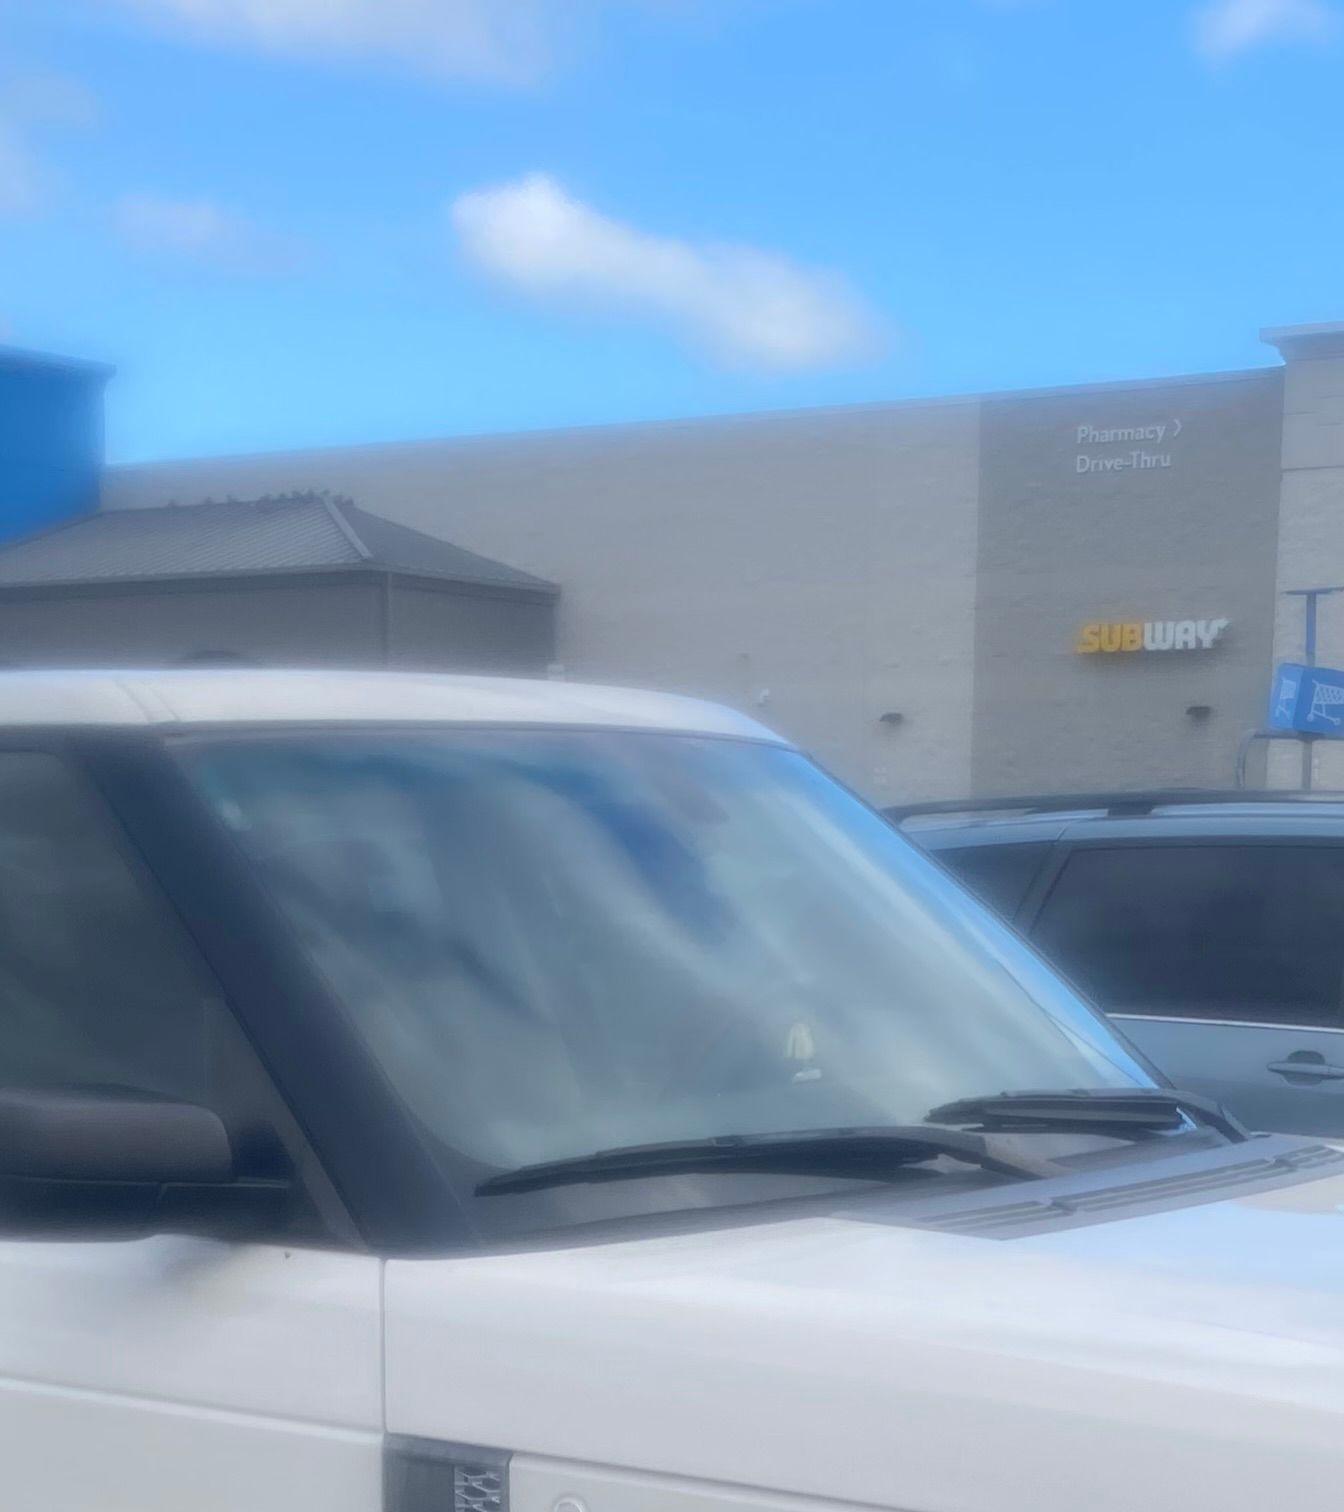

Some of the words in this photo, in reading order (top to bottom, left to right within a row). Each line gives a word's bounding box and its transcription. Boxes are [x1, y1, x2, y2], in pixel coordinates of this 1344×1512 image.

[1076, 425, 1166, 443] Pharmacy
[1076, 450, 1171, 473] Drive-Thru
[1076, 618, 1229, 653] SUBWAY
